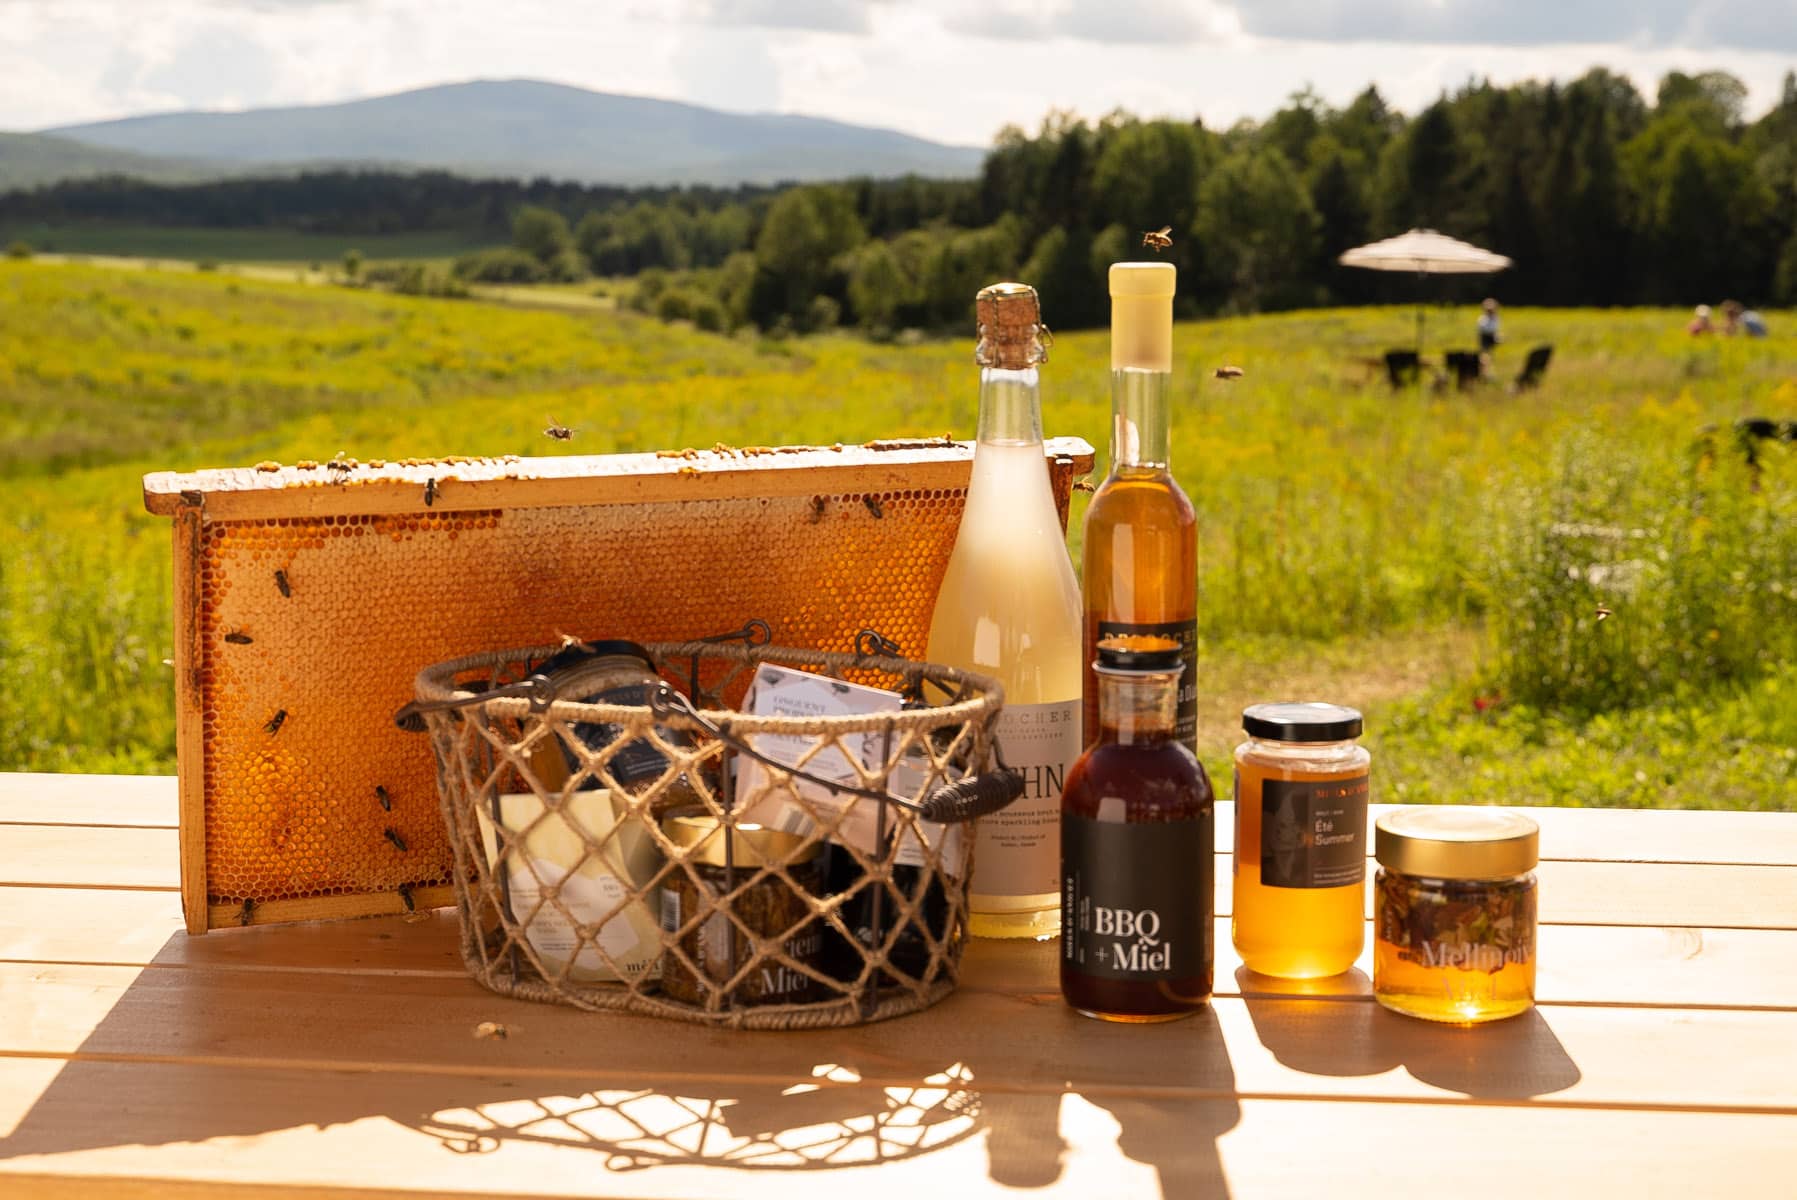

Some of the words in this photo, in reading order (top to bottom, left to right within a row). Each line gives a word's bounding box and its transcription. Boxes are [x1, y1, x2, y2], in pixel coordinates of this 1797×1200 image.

[1314, 819, 1334, 833] Été
[1314, 833, 1355, 846] Summer
[1094, 906, 1161, 946] BBQ
[1112, 942, 1171, 972] Miel
